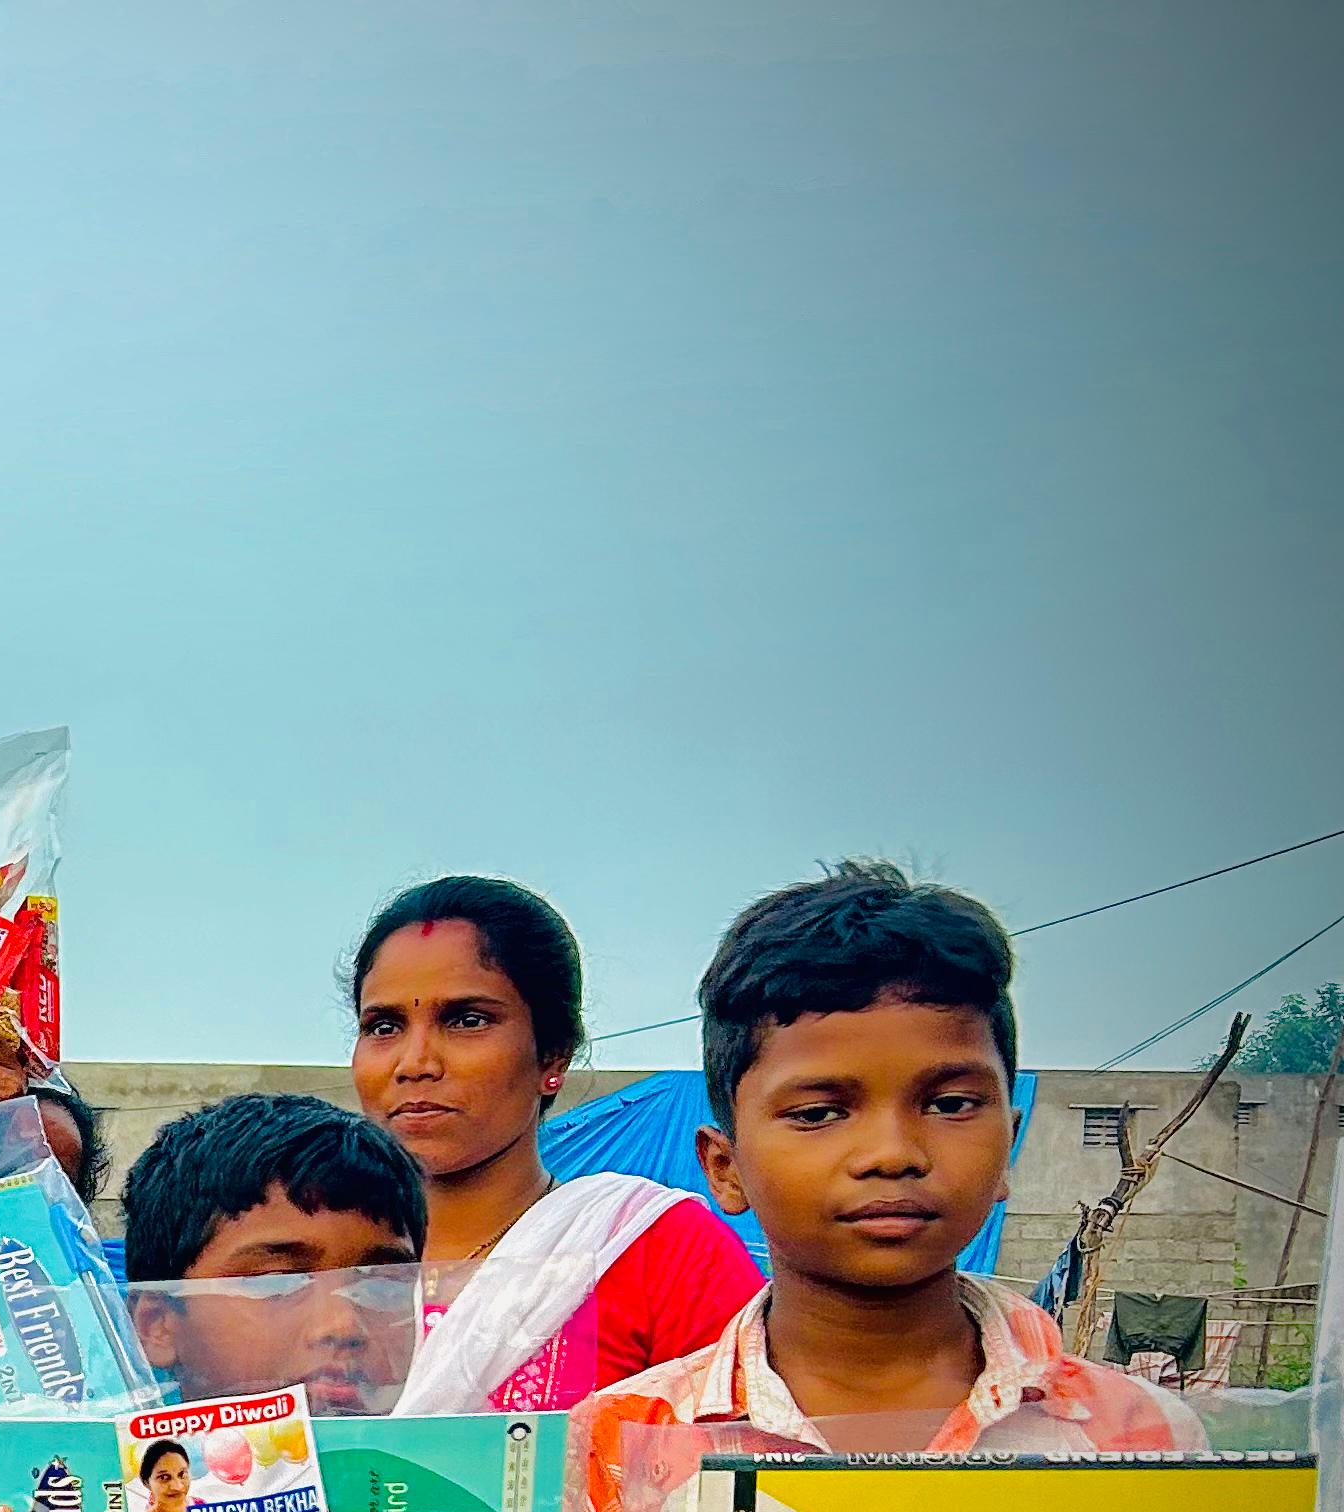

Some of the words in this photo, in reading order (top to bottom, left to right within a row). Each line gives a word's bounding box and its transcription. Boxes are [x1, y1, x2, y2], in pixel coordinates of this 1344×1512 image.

[14, 1302, 85, 1401] Friends
[139, 1412, 214, 1437] Happy
[219, 1396, 289, 1424] Diwali
